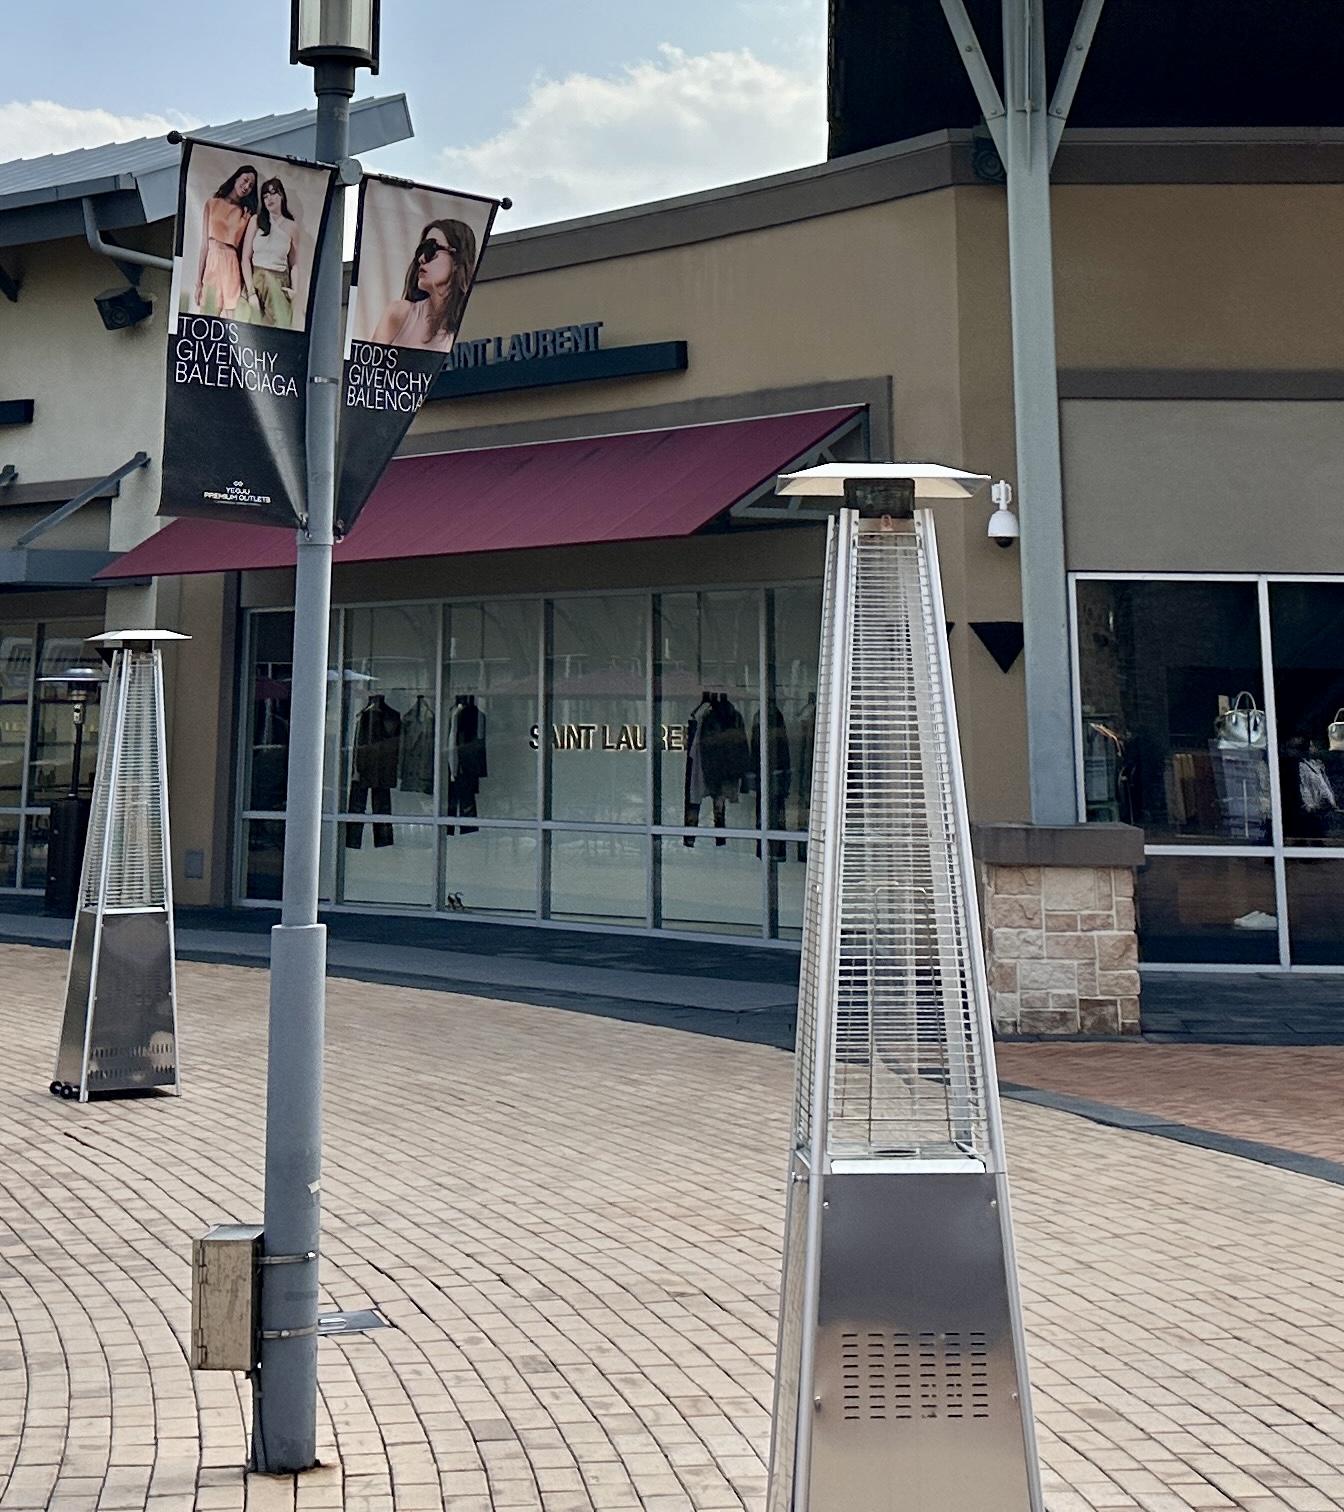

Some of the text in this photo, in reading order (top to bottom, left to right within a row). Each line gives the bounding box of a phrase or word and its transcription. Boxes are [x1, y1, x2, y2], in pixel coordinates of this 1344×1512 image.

[178, 316, 239, 344] TOD'S
[176, 340, 278, 373] GIVENCHY
[352, 343, 398, 368] TOD'S
[443, 321, 604, 371] AINT LAURENT
[175, 362, 298, 398] BALENCIAGA
[349, 365, 433, 393] GIVENCHY
[601, 723, 689, 753] LAURE
